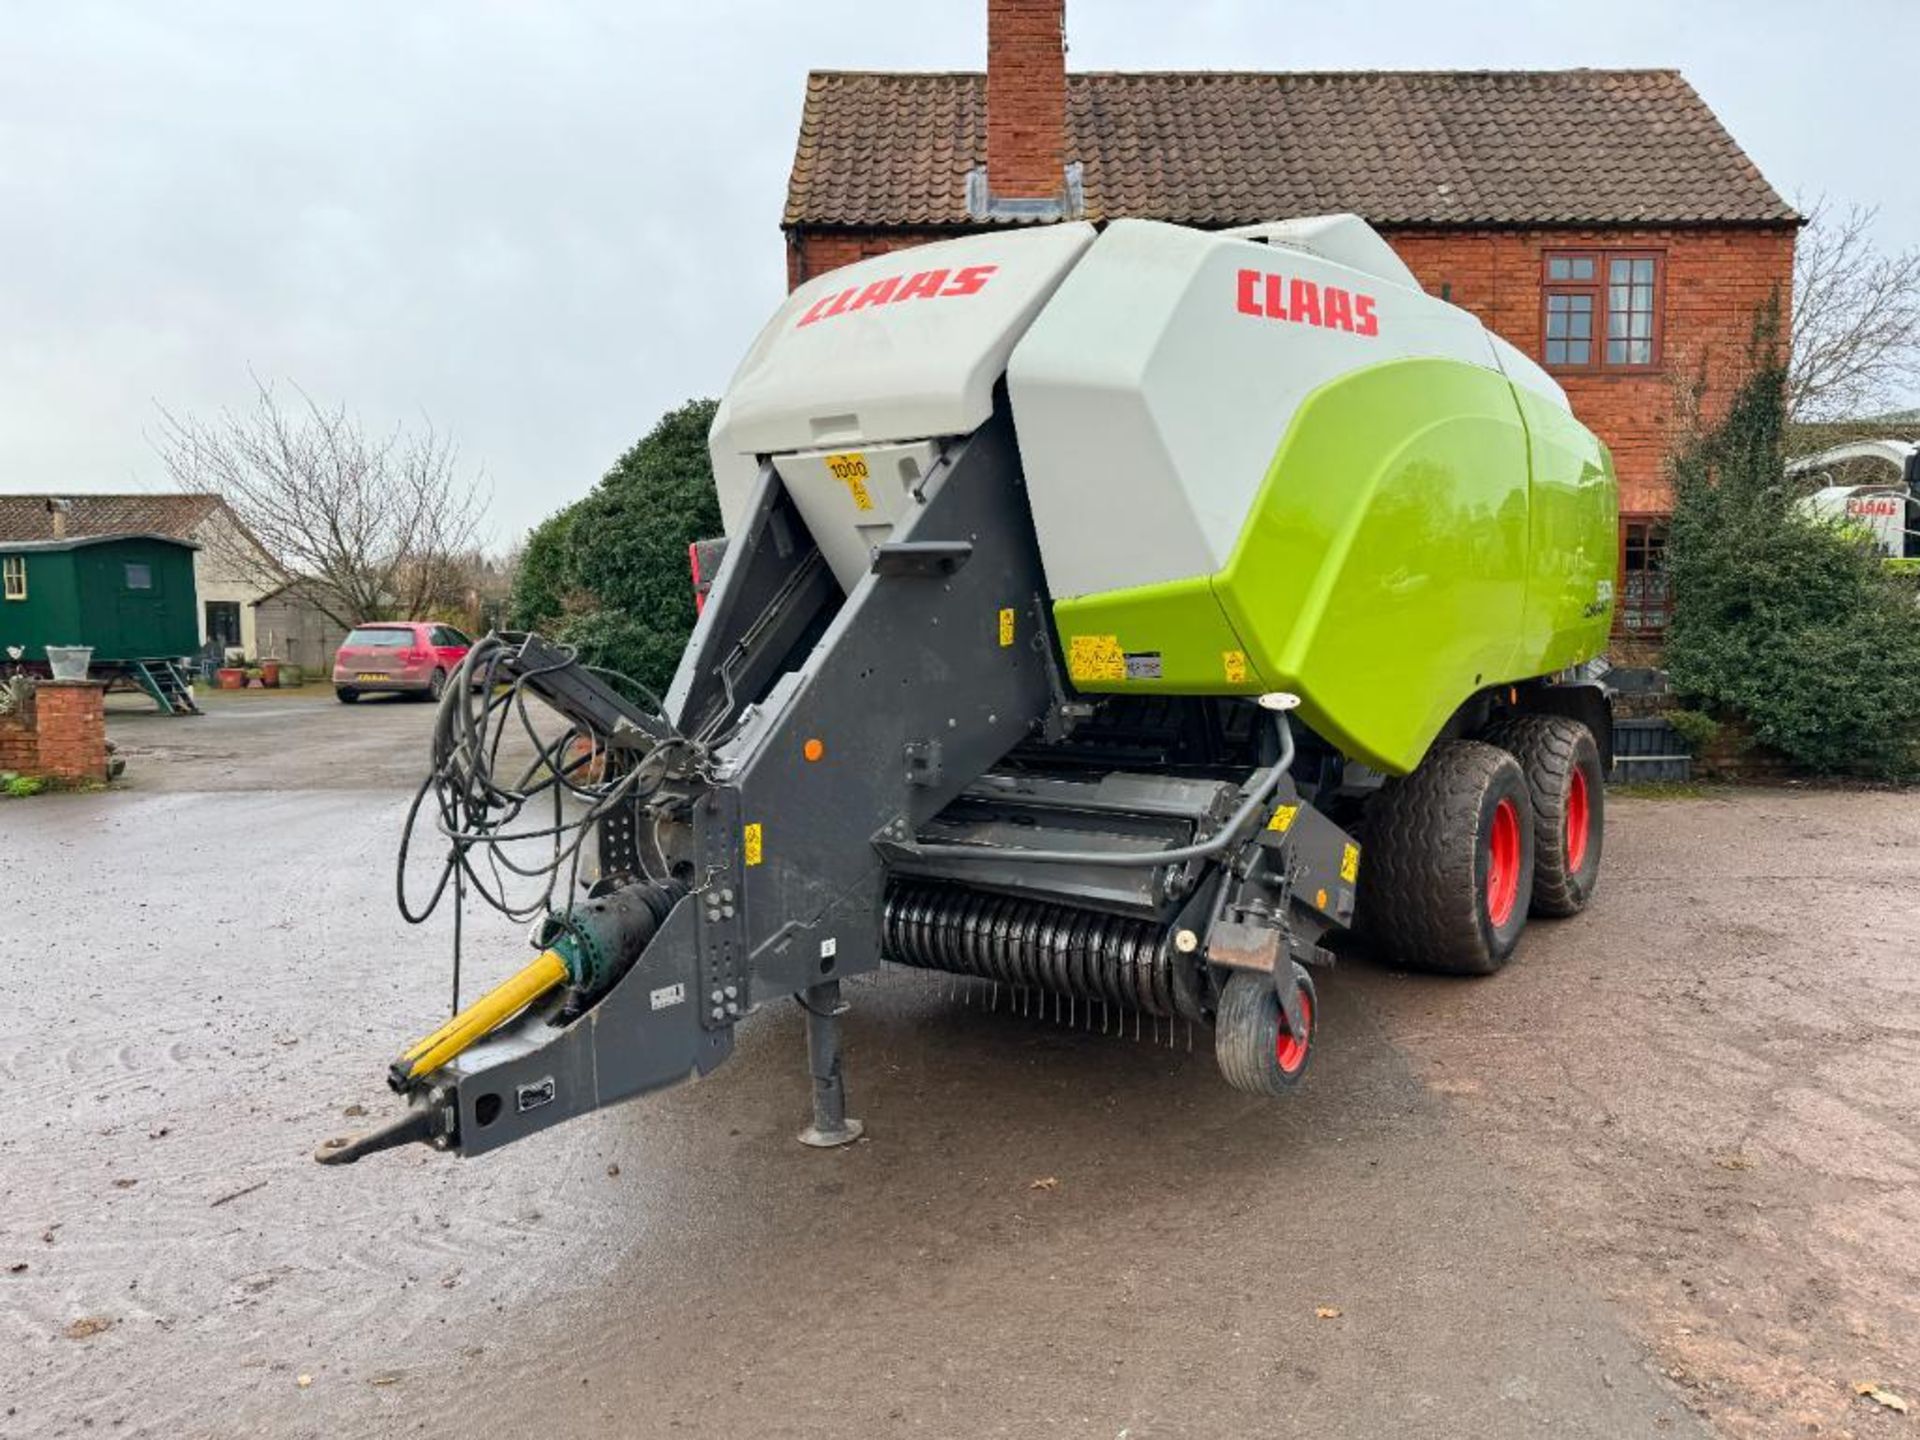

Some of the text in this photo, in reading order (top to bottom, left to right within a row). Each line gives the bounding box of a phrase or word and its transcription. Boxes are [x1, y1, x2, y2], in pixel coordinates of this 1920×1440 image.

[797, 265, 998, 328] CLAAS
[1236, 268, 1379, 337] CLAAS
[831, 461, 868, 479] 1000
